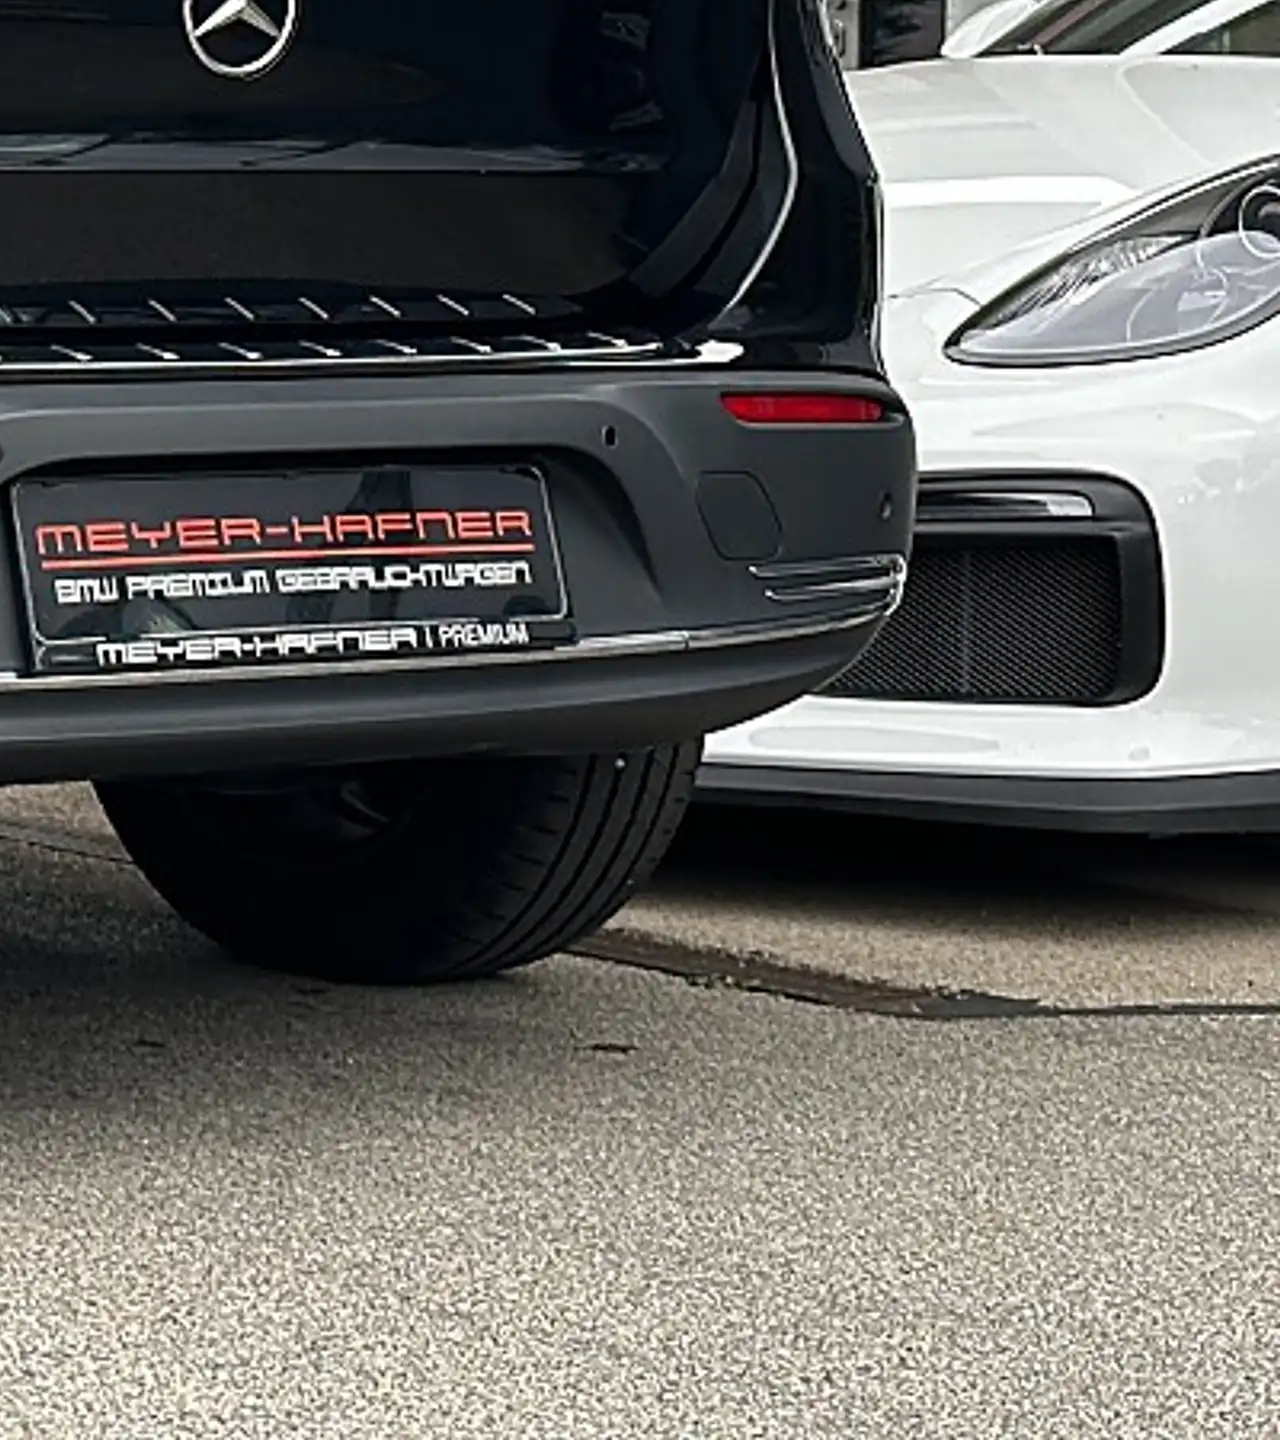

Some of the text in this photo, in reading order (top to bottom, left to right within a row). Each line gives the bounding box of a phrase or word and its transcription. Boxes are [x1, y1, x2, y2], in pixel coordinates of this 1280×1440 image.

[36, 510, 533, 555] MEYER-HAFNER
[54, 560, 532, 603] BMW PREMIUM GEBRAUCHTWAGEN
[96, 626, 418, 667] MEYER-HAFNER
[438, 623, 530, 647] PREMIUM
